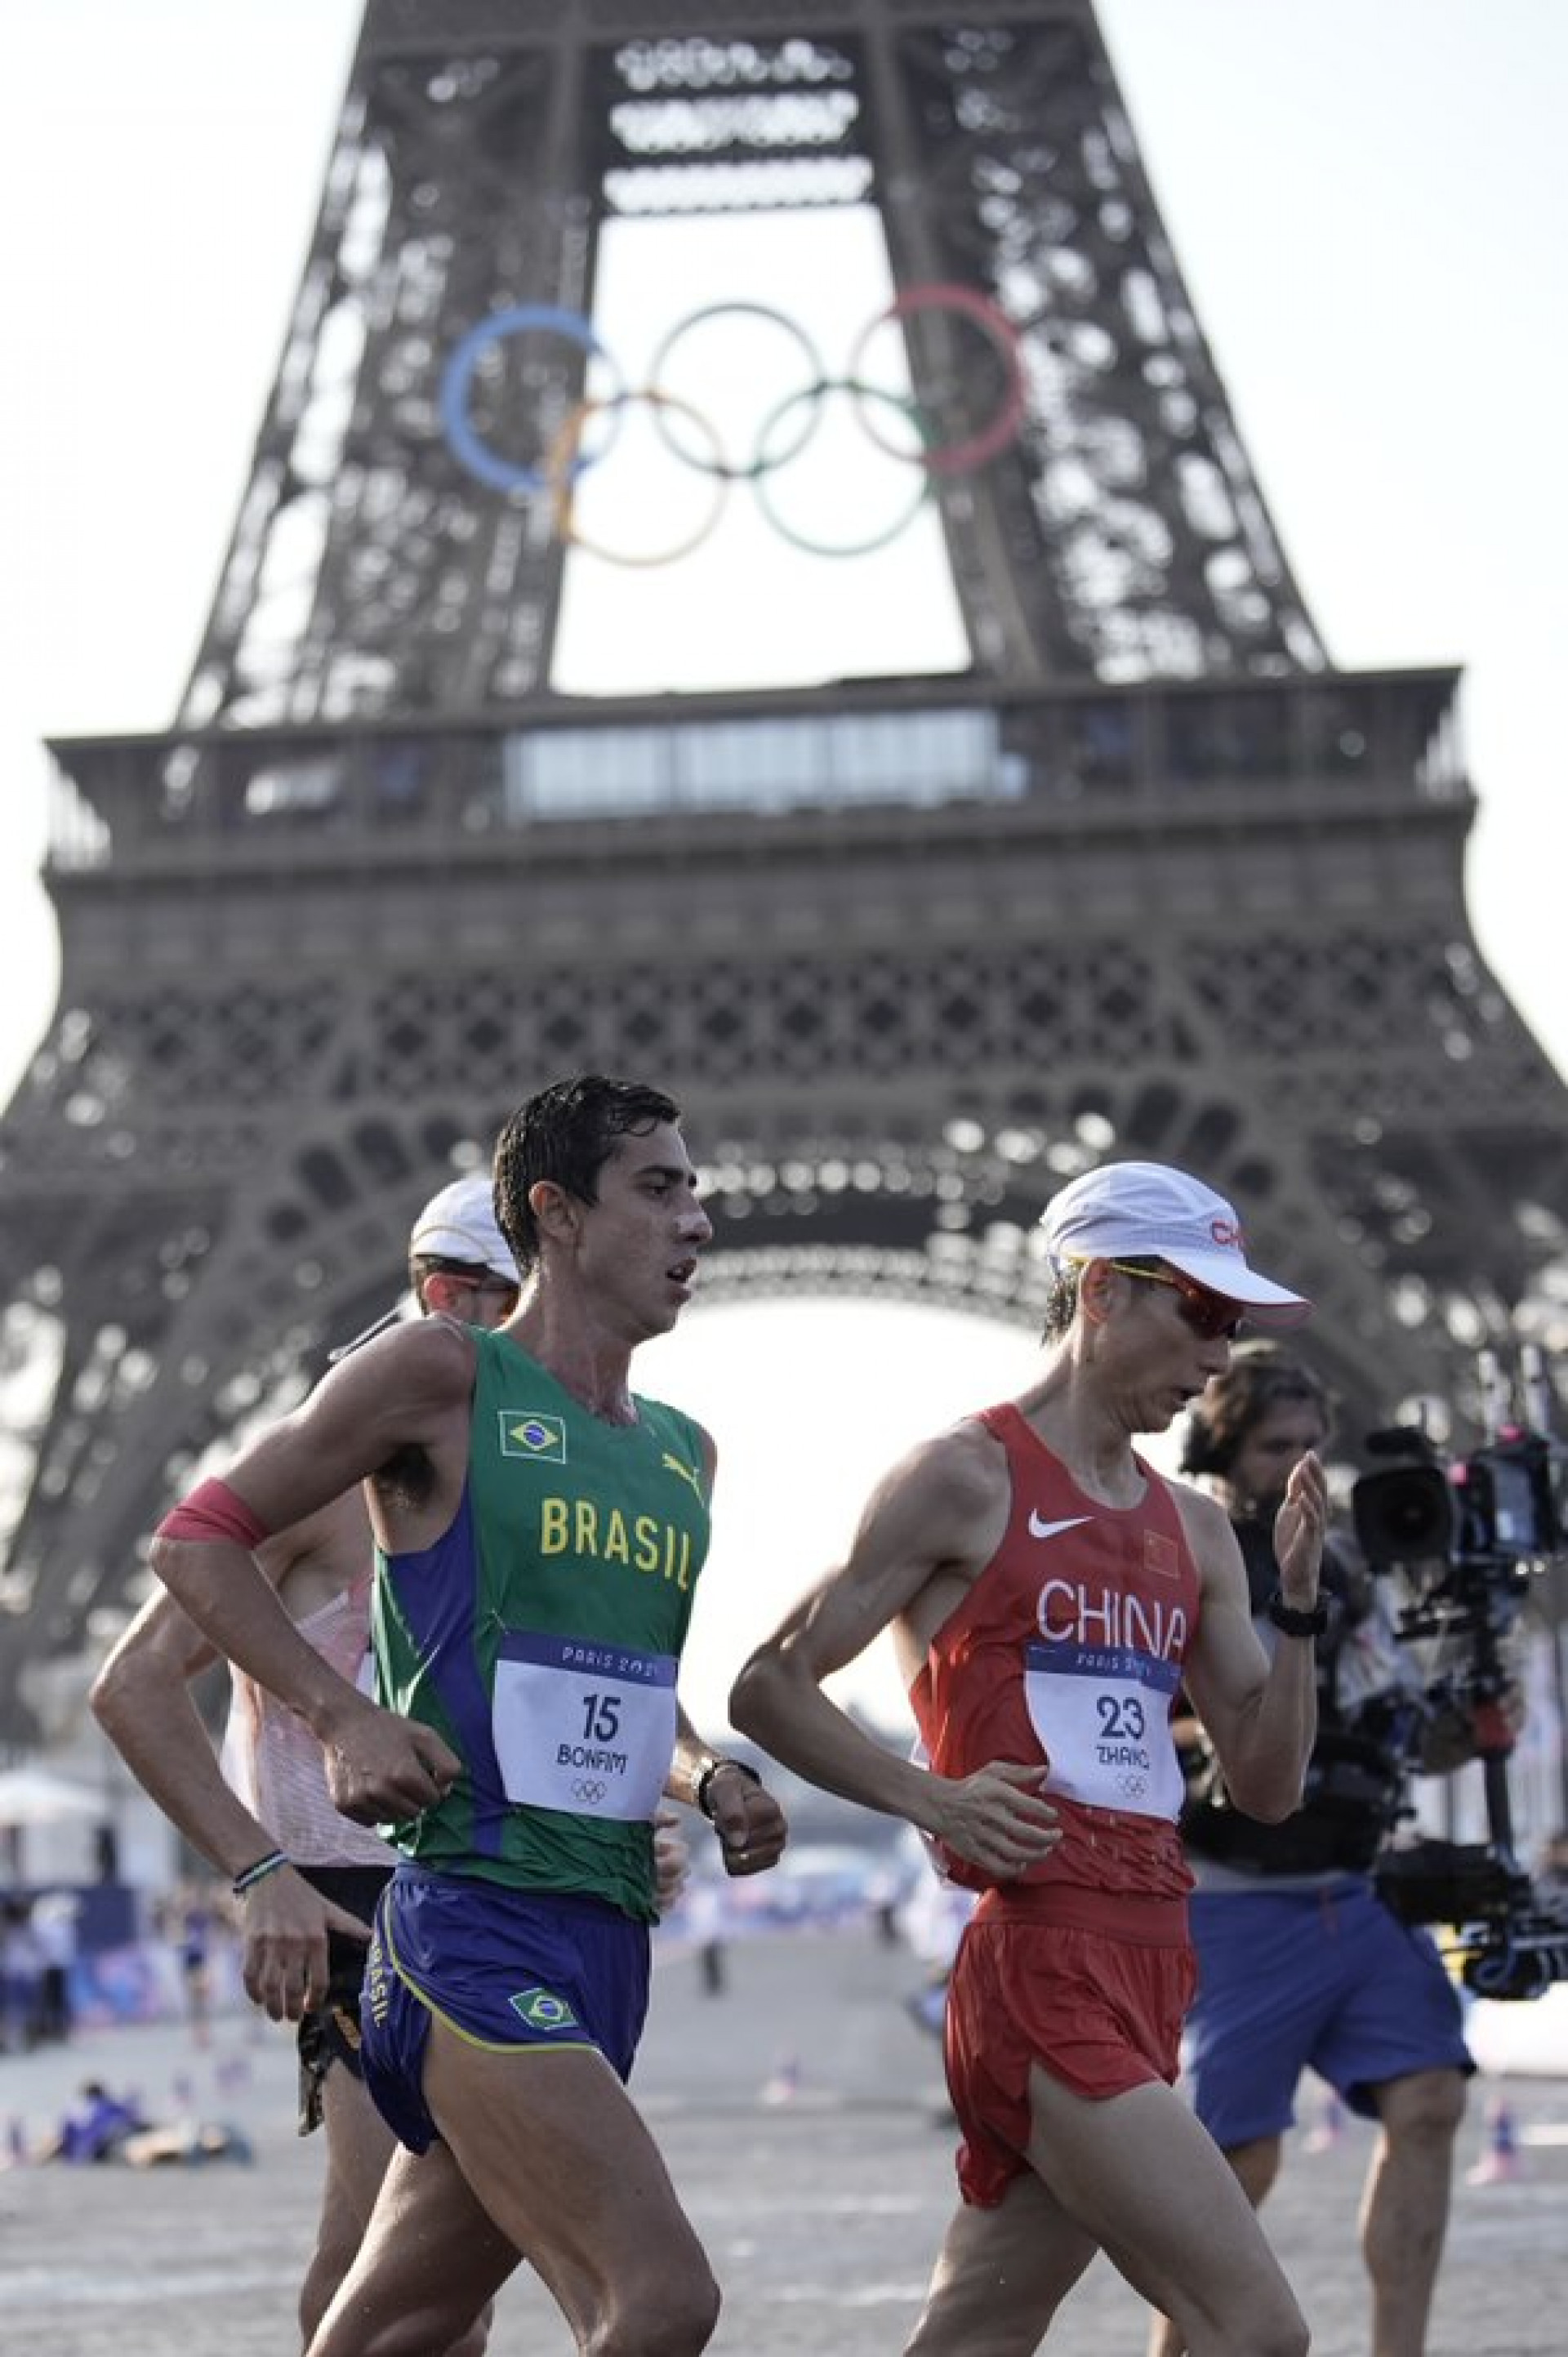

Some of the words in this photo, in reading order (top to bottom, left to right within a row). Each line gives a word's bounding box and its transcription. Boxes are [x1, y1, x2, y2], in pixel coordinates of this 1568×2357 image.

[540, 1498, 690, 1590] BRASIL
[1036, 1579, 1187, 1660] CHINA
[562, 1646, 612, 1669] PARIS
[583, 1694, 621, 1742] 15
[1096, 1695, 1145, 1741] 23
[557, 1744, 628, 1776] BONFIM
